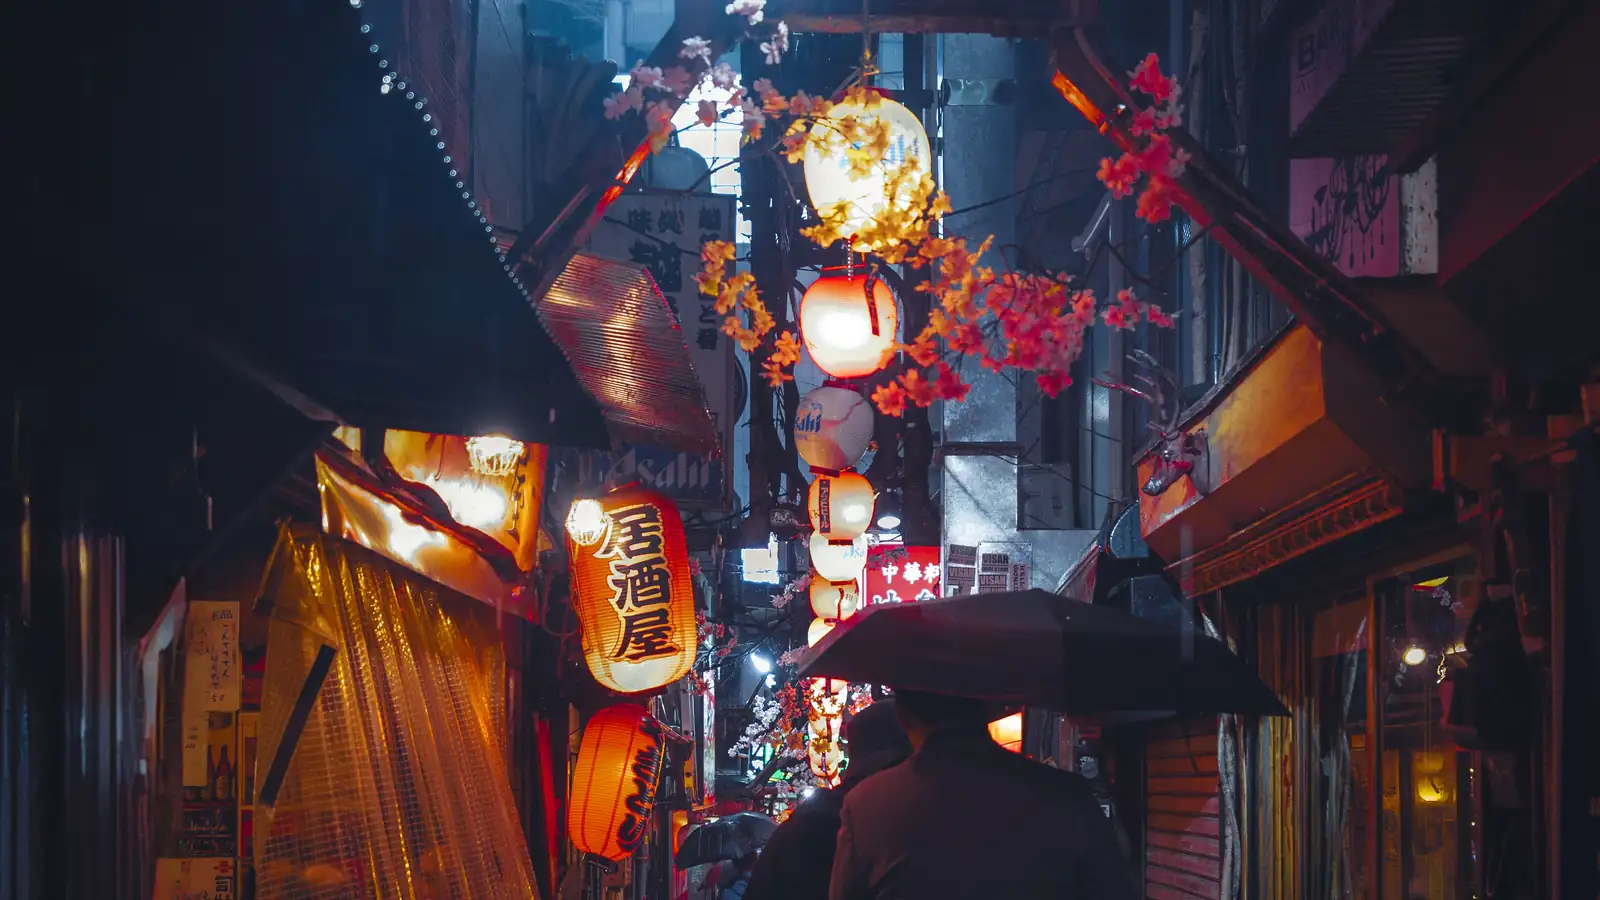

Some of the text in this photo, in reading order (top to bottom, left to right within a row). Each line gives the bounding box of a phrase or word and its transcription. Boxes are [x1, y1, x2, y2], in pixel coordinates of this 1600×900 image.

[604, 446, 711, 489] Asahi
[598, 504, 678, 660] 居酒屋
